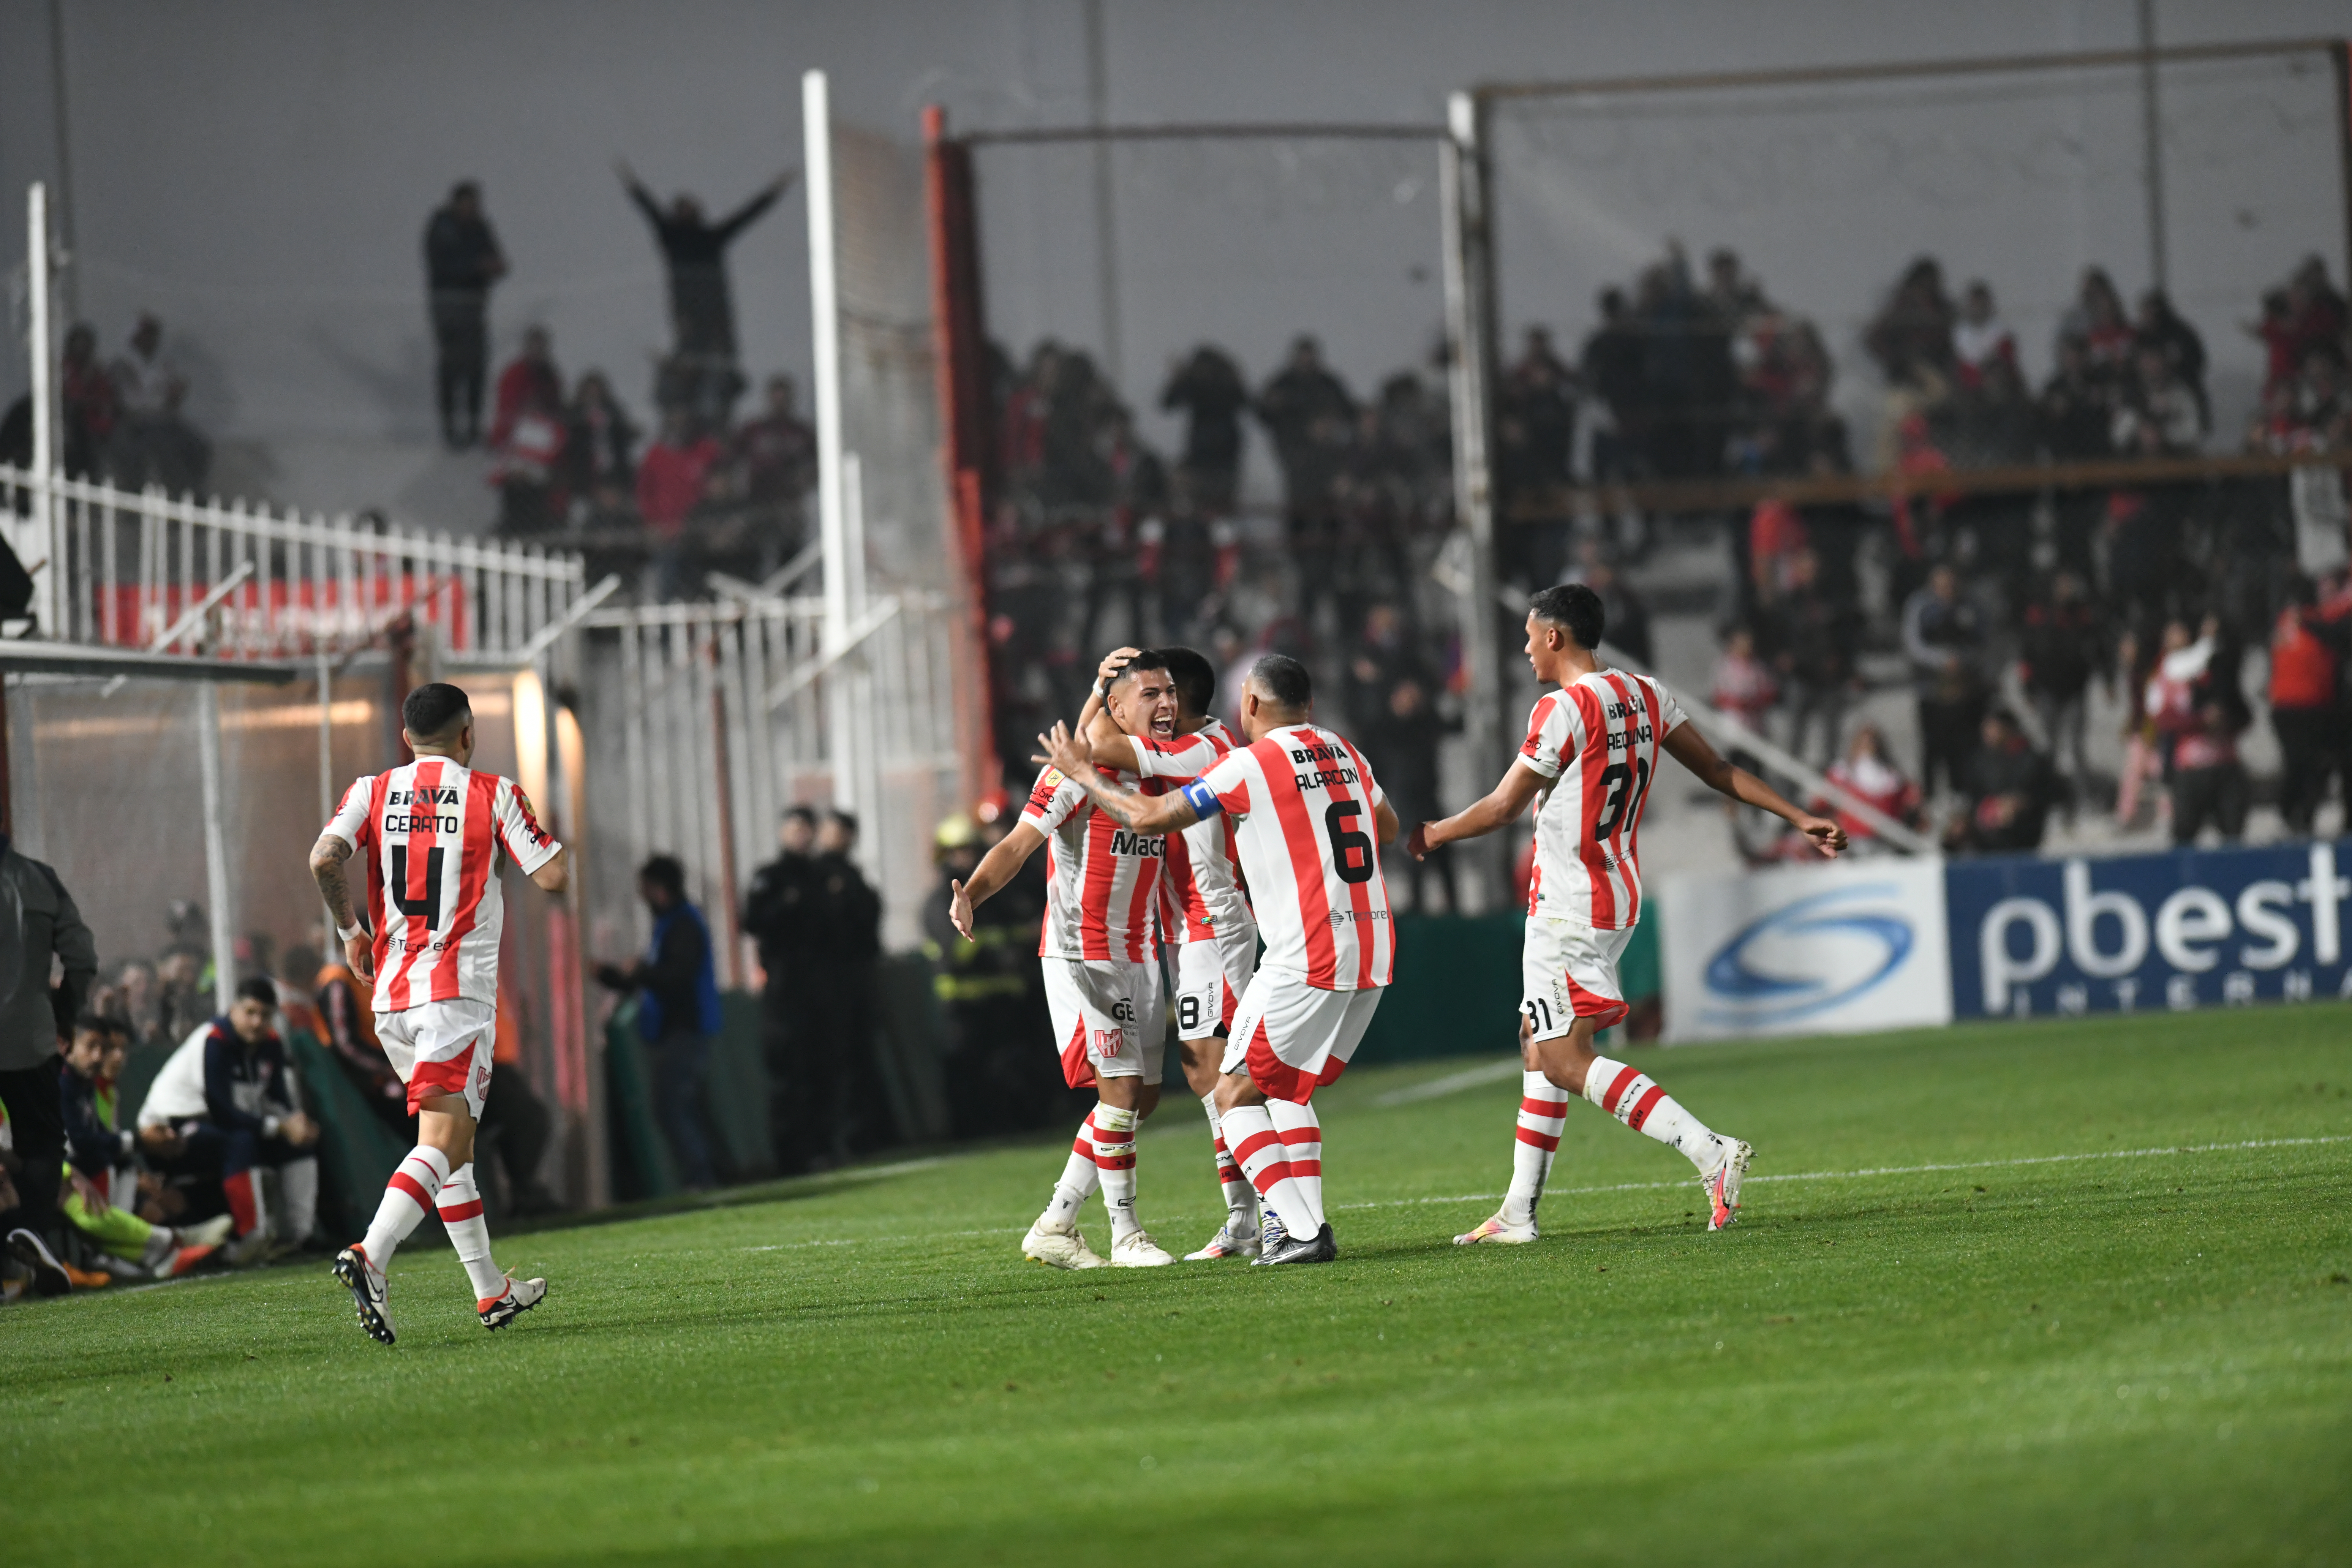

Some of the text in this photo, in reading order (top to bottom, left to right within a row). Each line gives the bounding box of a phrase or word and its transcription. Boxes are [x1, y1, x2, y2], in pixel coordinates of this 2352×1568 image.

[1606, 698, 1646, 720] BRAA
[1607, 725, 1653, 751] REQUNA
[1291, 746, 1348, 764] BRAVA
[1295, 767, 1359, 792] ALARCON
[389, 789, 459, 805] BRAVA
[1190, 782, 1215, 808] C
[1595, 757, 1649, 842] 31
[385, 815, 458, 833] CERATO
[1325, 800, 1374, 884] 6
[391, 845, 444, 931] 4
[397, 939, 452, 953] Tecned
[1552, 979, 1563, 1014] GIVOVA
[1526, 998, 1552, 1035] 31
[1234, 1016, 1252, 1050] GIVOVA
